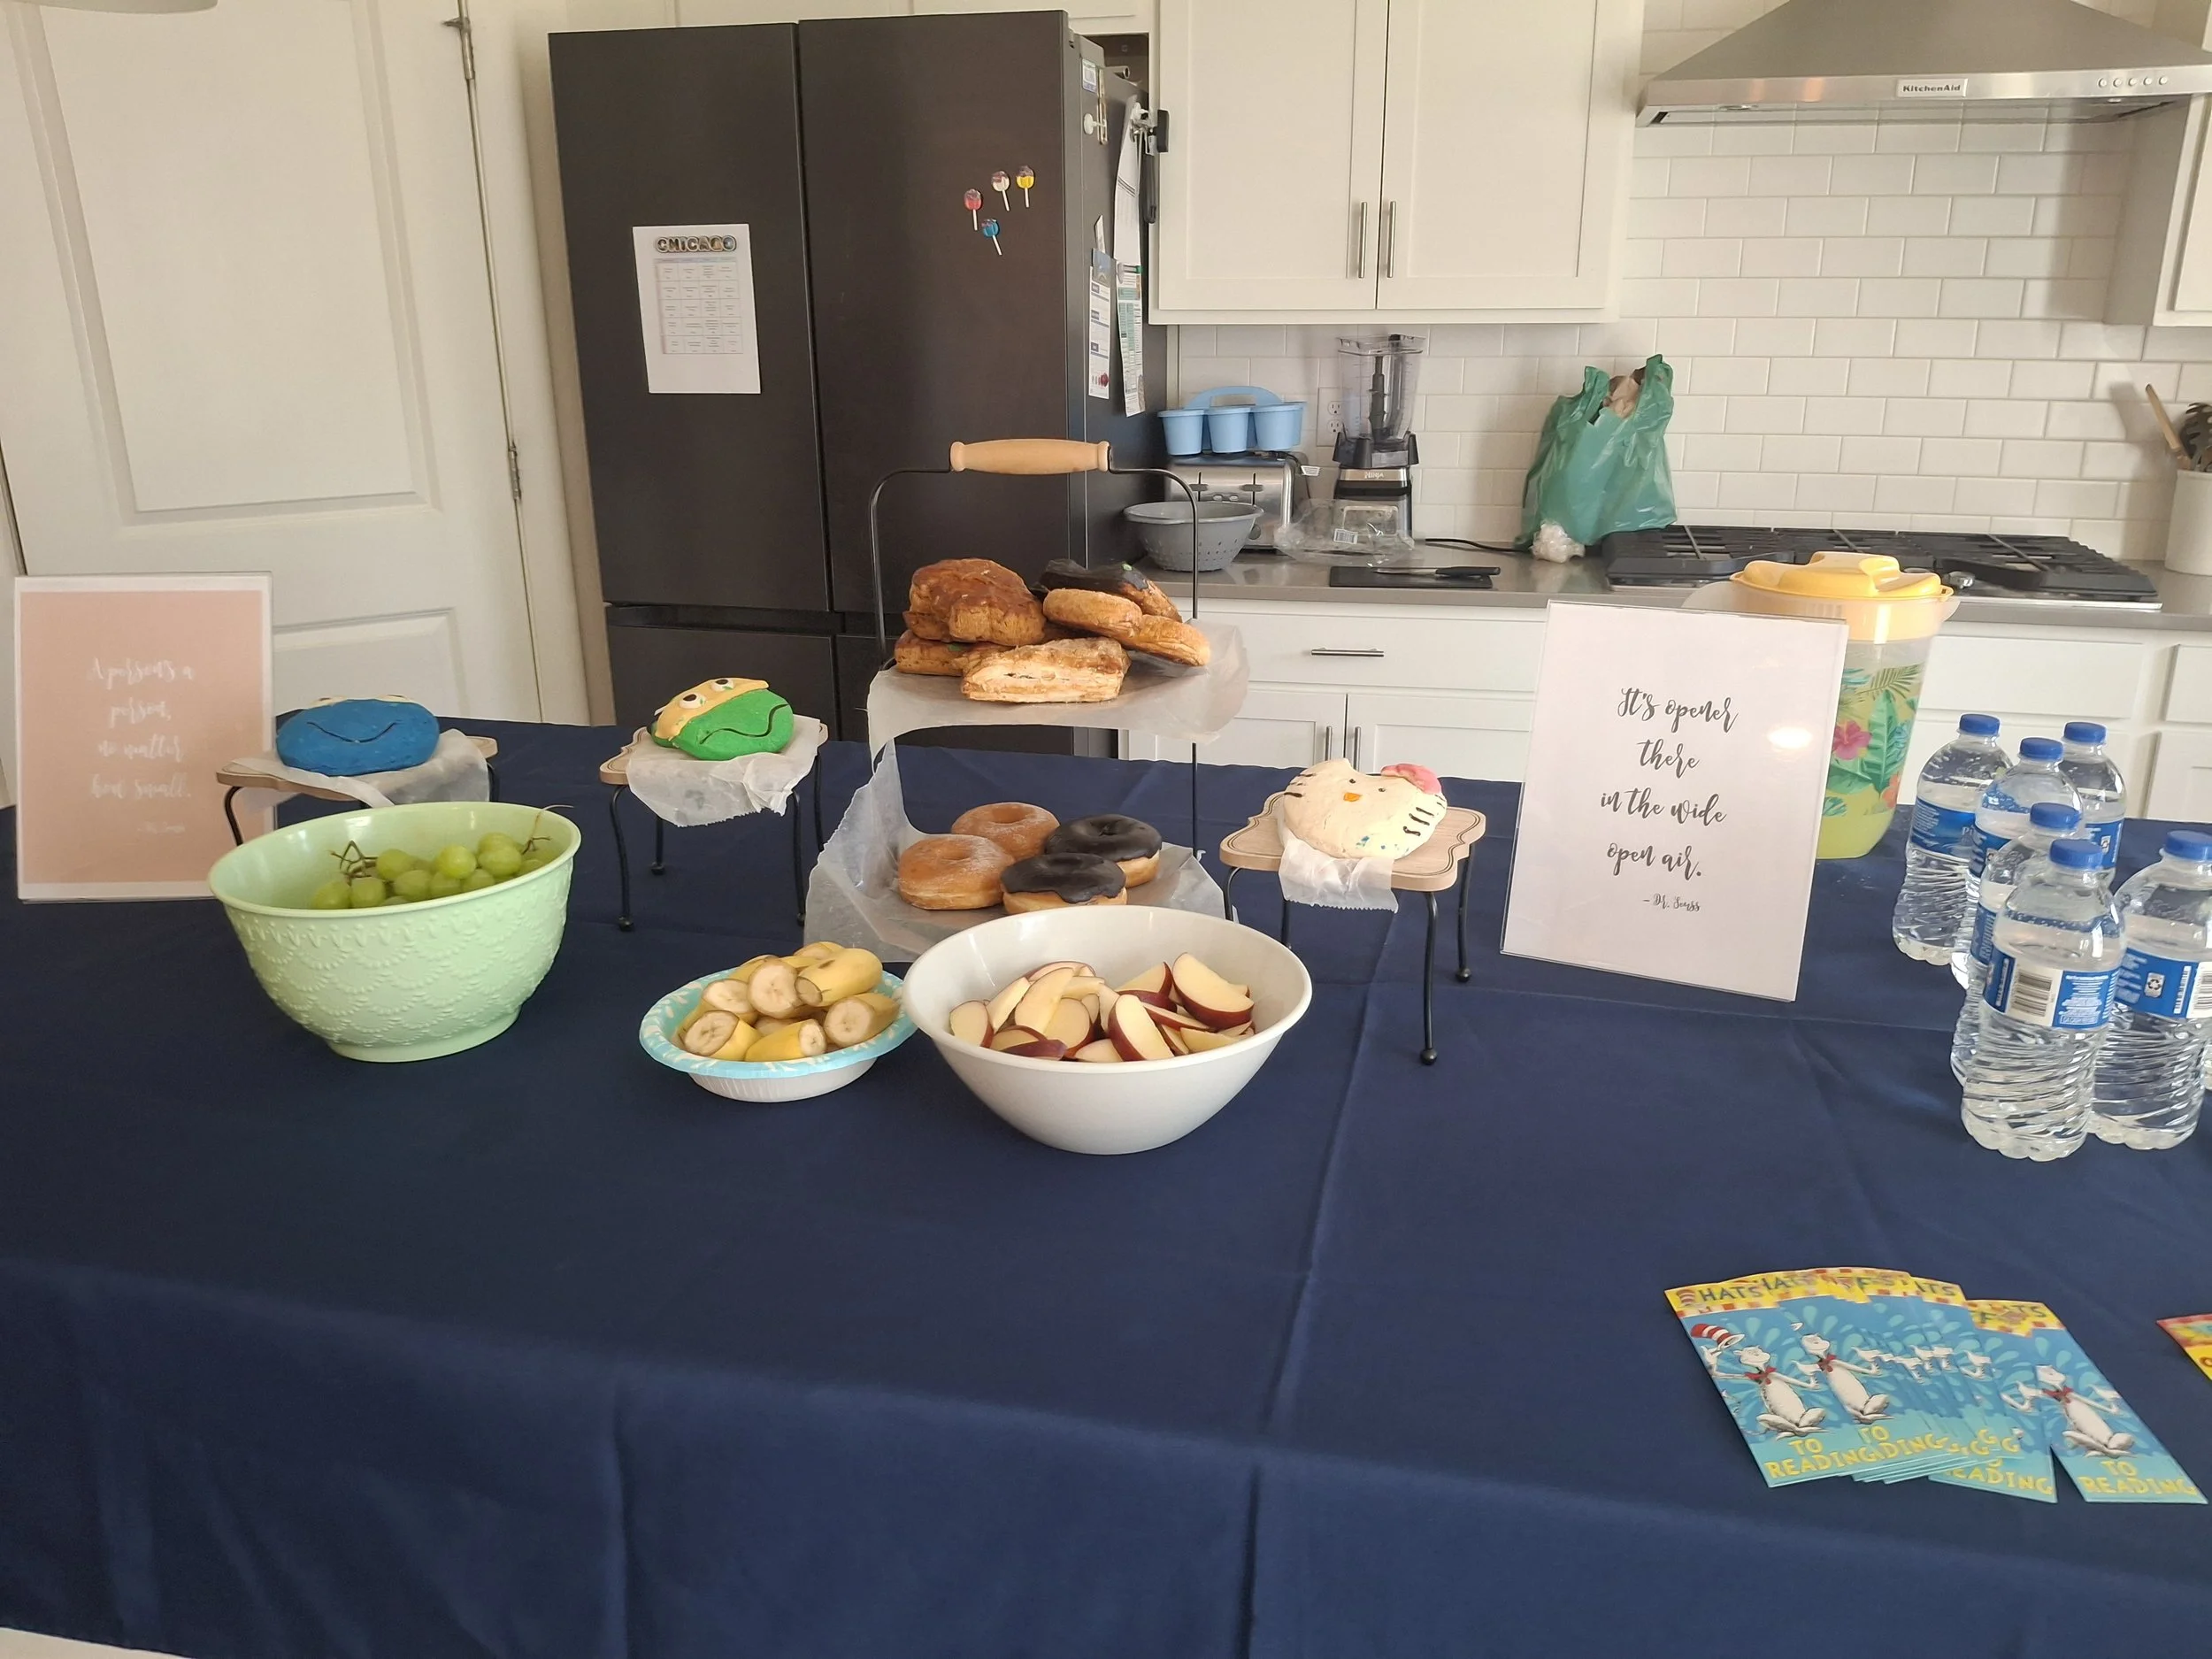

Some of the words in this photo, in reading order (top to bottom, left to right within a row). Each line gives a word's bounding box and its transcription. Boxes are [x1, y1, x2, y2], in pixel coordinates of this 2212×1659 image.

[1902, 84, 1961, 93] KitchenAid
[1617, 687, 1661, 721] It's
[1664, 697, 1739, 733] opener
[1637, 739, 1700, 779] there
[1601, 792, 1622, 813] in
[1624, 787, 1664, 819] the
[1671, 793, 1727, 826] wide
[1607, 842, 1656, 877] open
[1662, 845, 1702, 881] air.
[1673, 896, 1701, 912] Seuss
[1698, 1286, 1763, 1302] HATS
[1788, 1438, 1824, 1455] TO
[1764, 1446, 1878, 1479] READING
[2100, 1461, 2137, 1477] TO
[2078, 1476, 2198, 1496] READING
